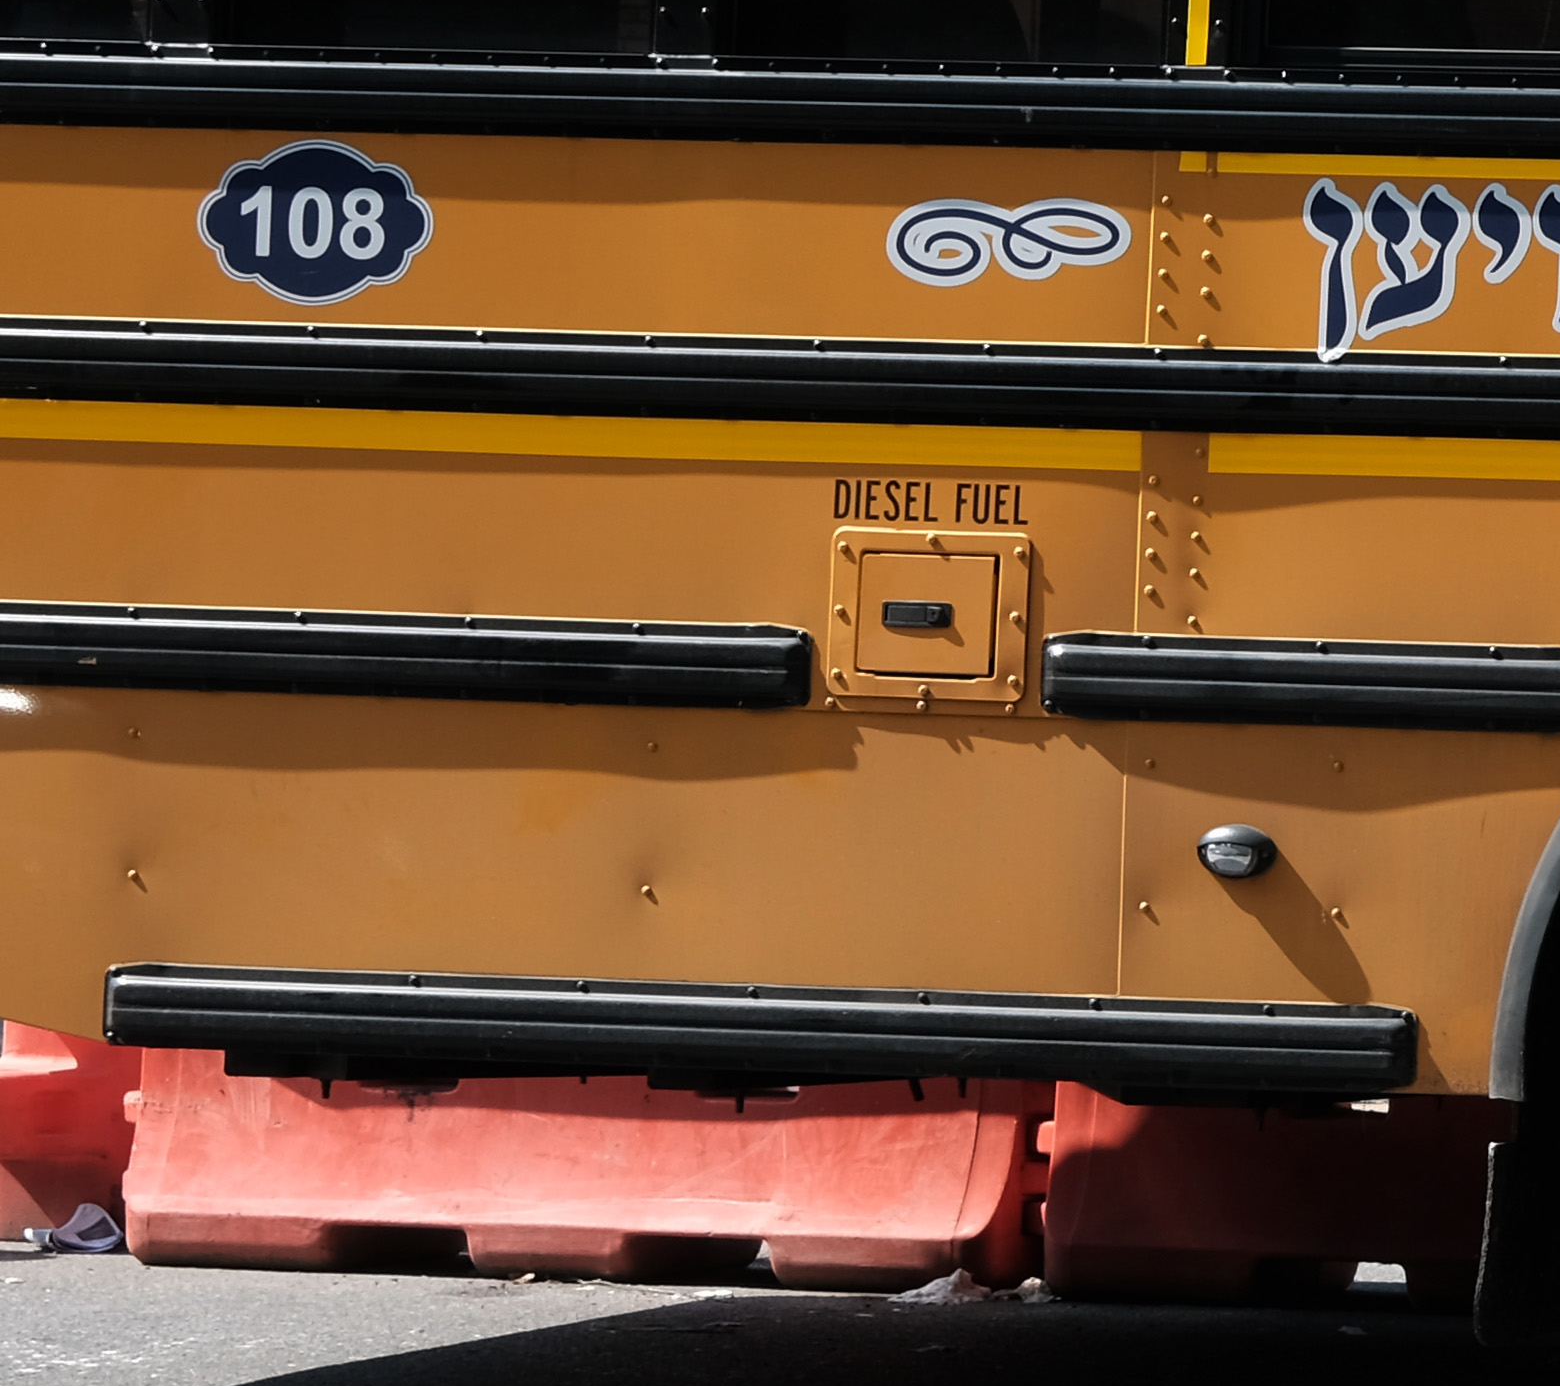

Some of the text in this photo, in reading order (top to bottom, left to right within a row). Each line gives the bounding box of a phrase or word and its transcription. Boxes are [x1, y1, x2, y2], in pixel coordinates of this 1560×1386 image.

[238, 184, 386, 261] 108
[833, 479, 1029, 525] DIESEL FUEL
